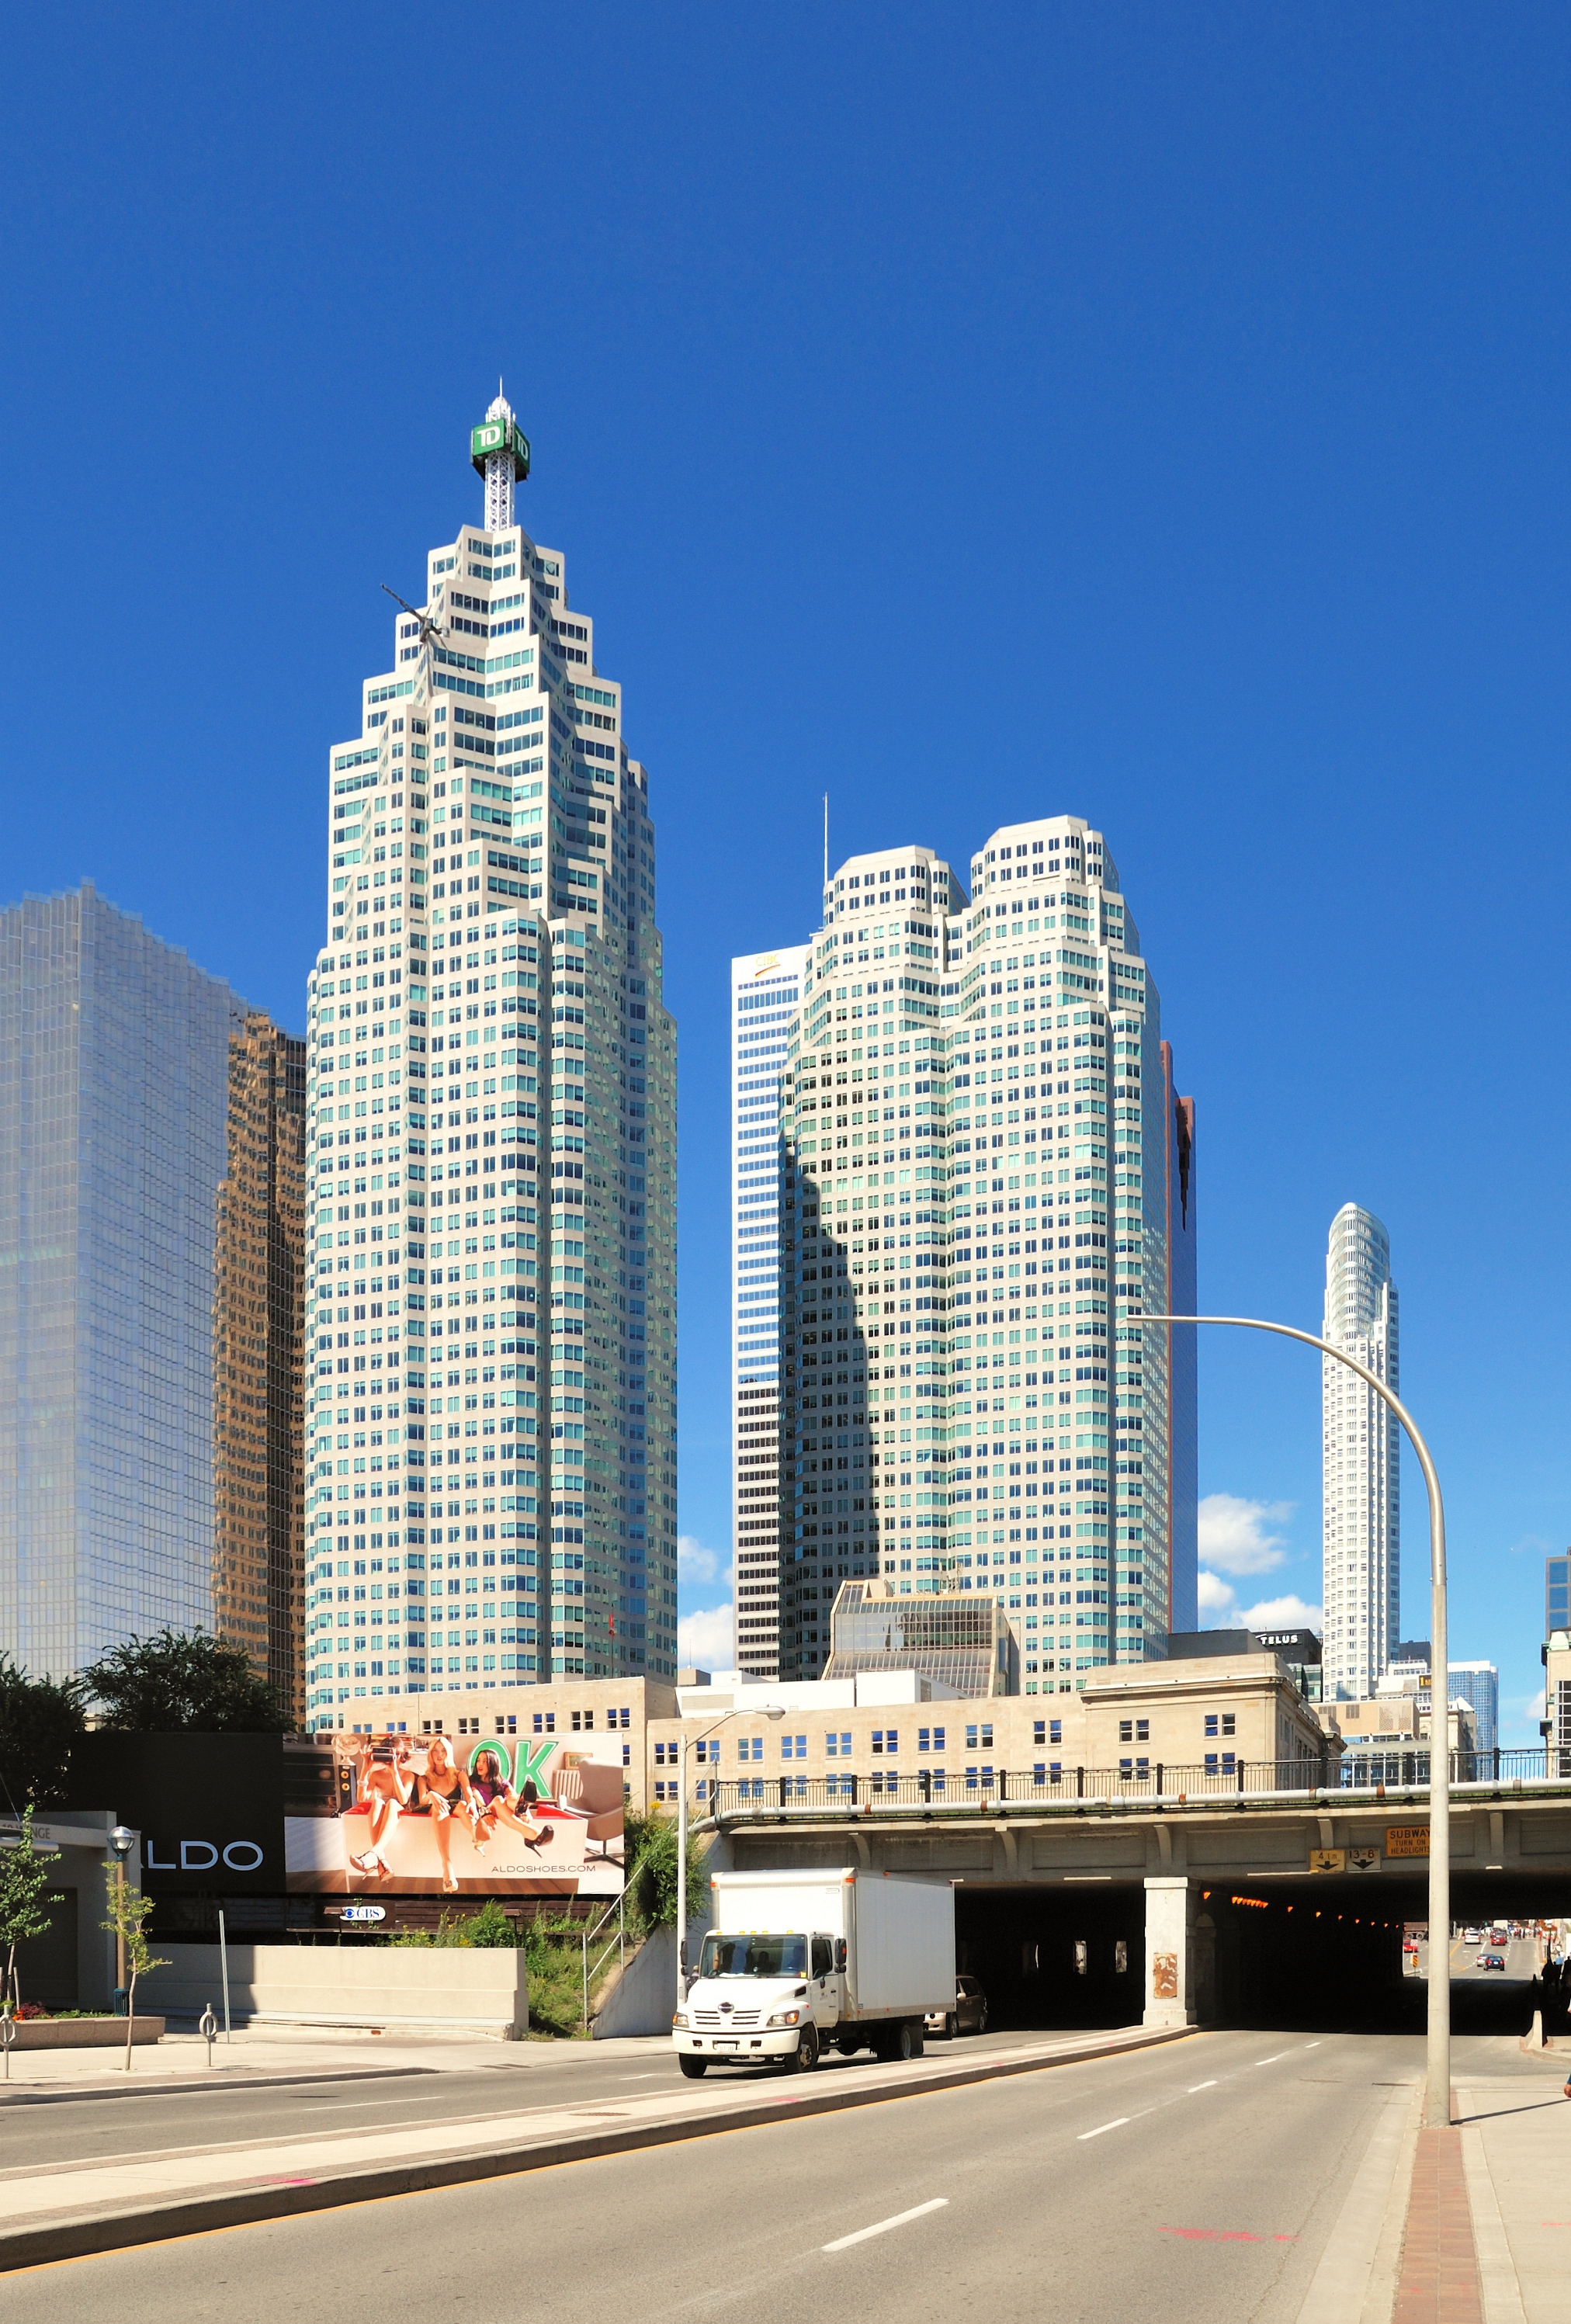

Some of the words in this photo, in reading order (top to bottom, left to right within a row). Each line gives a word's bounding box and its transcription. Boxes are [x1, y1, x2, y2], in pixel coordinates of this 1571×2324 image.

[477, 425, 501, 447] TD
[515, 429, 529, 461] TD
[755, 953, 780, 966] CIBC
[1260, 1634, 1299, 1646] TELUS
[467, 1739, 559, 1798] OK
[141, 1840, 264, 1871] LDO
[356, 1908, 380, 1919] CBS
